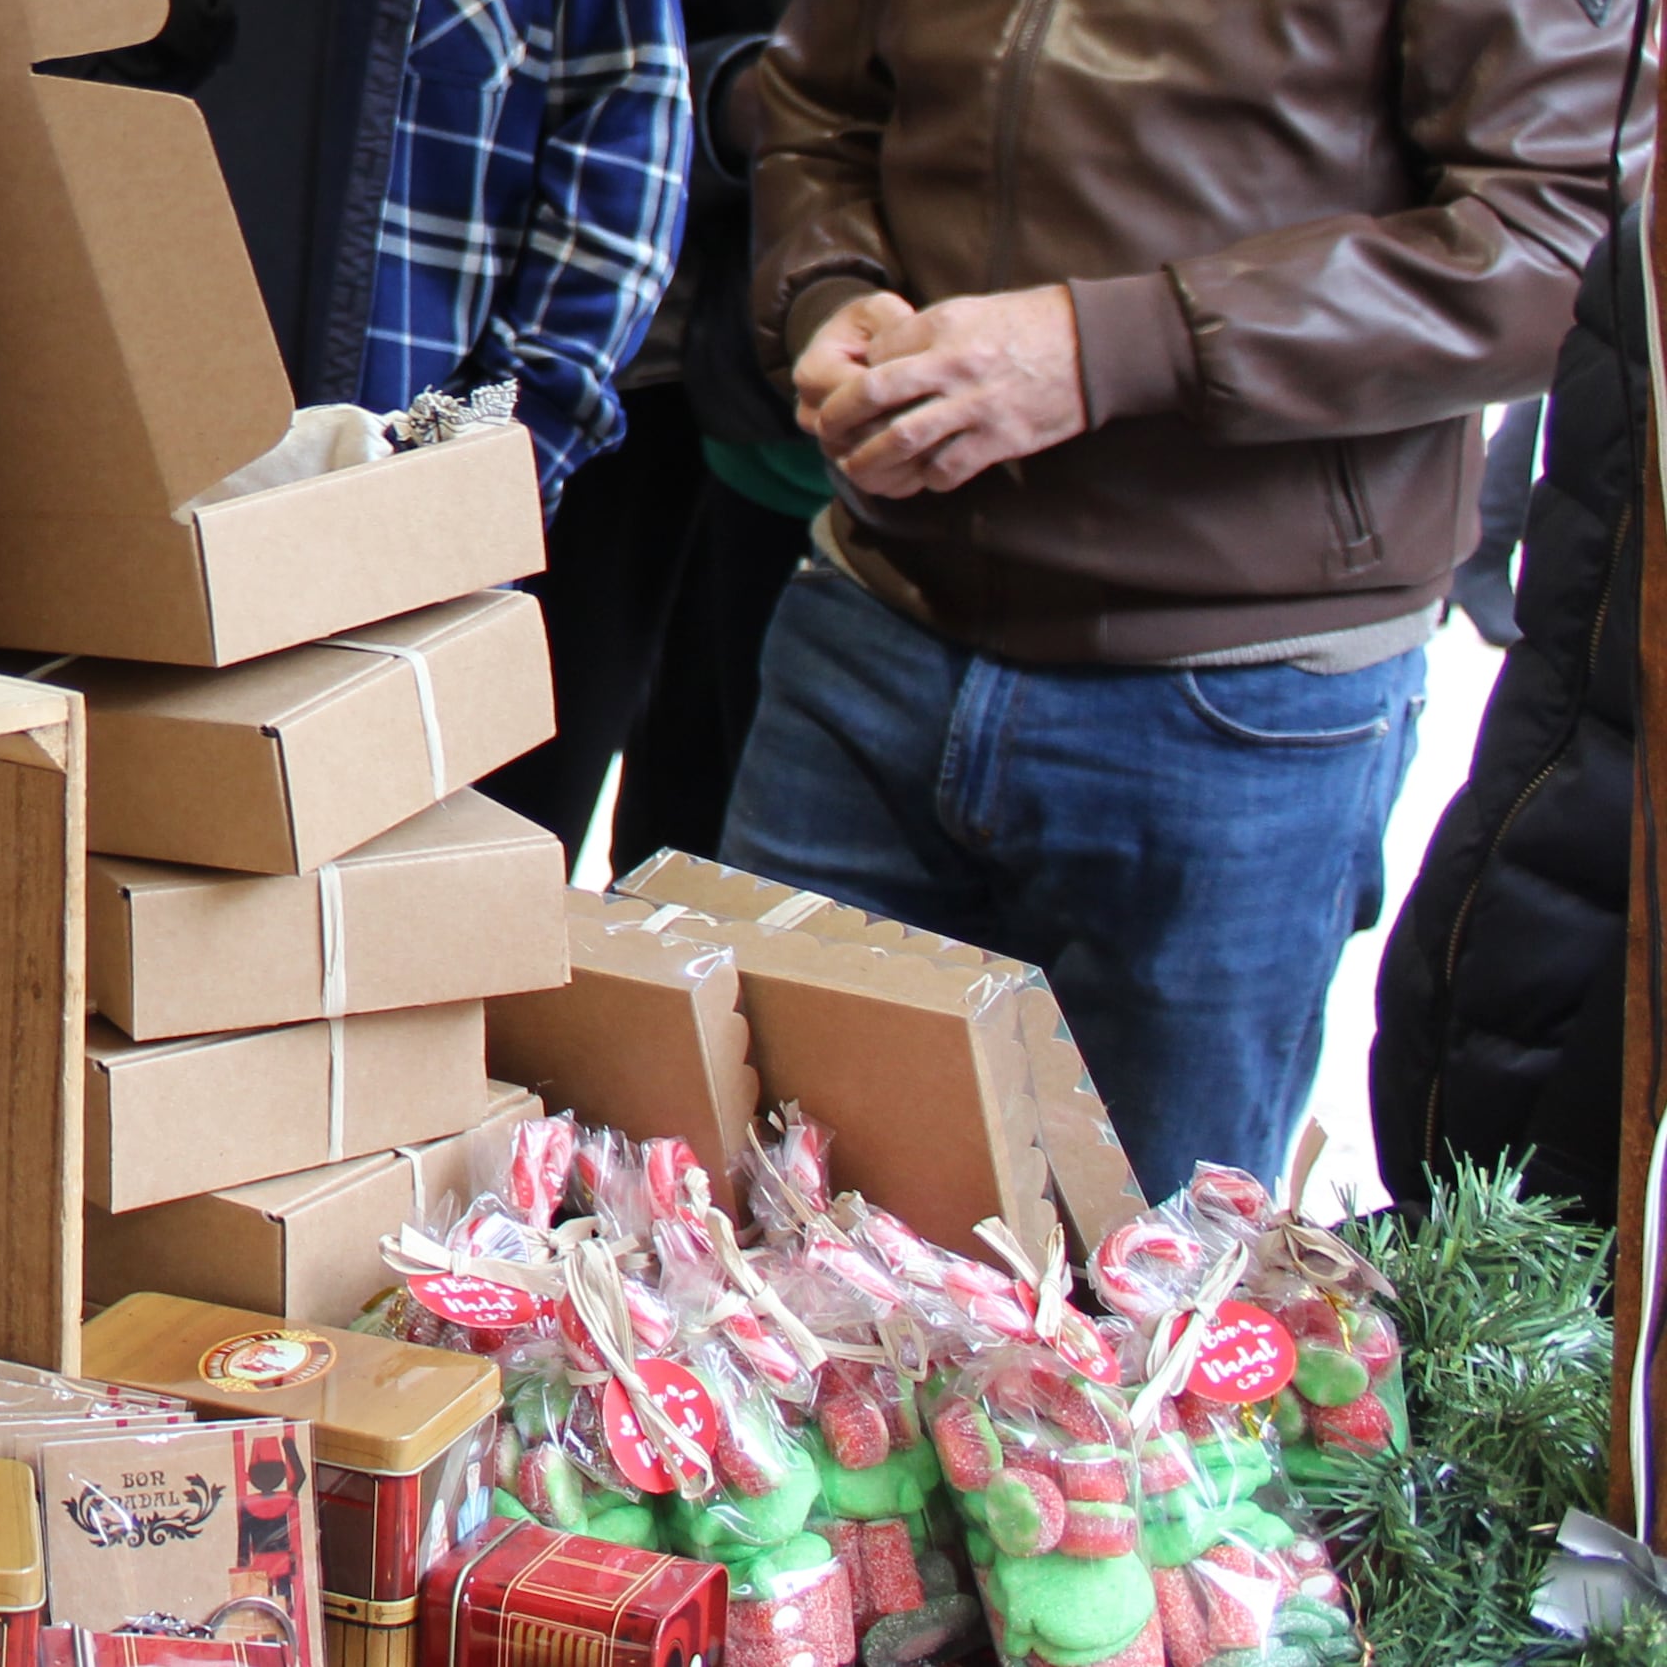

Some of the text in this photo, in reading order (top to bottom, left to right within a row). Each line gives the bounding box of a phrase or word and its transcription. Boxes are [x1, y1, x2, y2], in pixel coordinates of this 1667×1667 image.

[442, 1296, 519, 1314] Nadal
[1199, 1338, 1279, 1384] Nadal
[121, 1470, 167, 1489] BON
